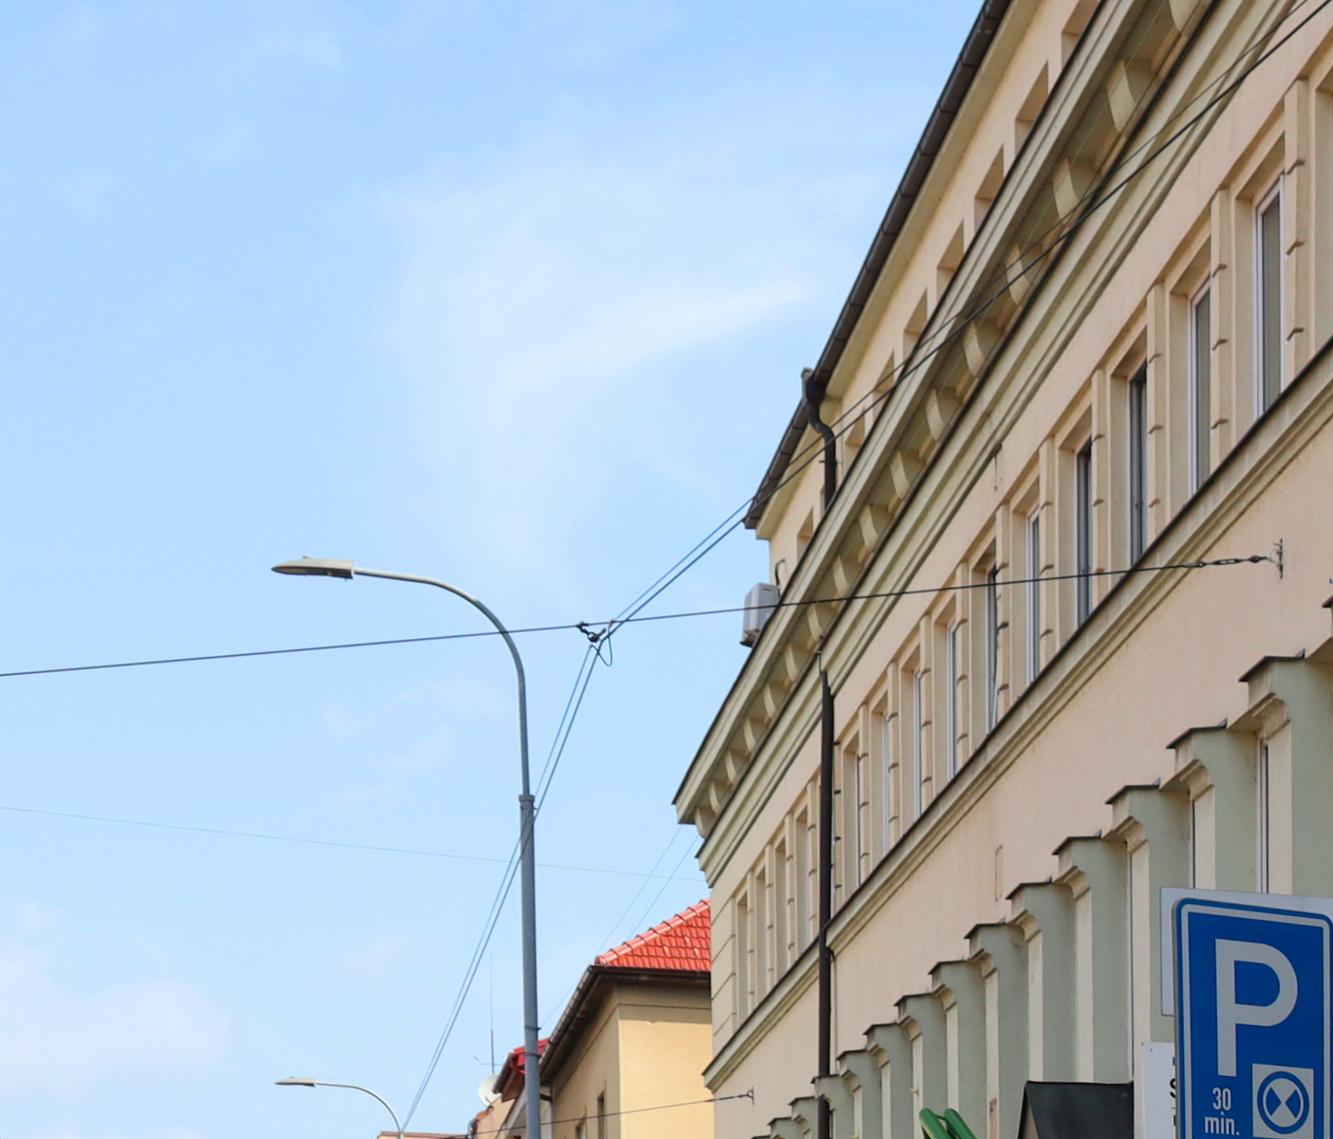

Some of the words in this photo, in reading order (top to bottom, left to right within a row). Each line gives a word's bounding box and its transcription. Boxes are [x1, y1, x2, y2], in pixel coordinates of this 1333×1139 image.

[1215, 938, 1298, 1077] P
[1212, 1087, 1232, 1111] 30
[1204, 1111, 1240, 1136] min.
